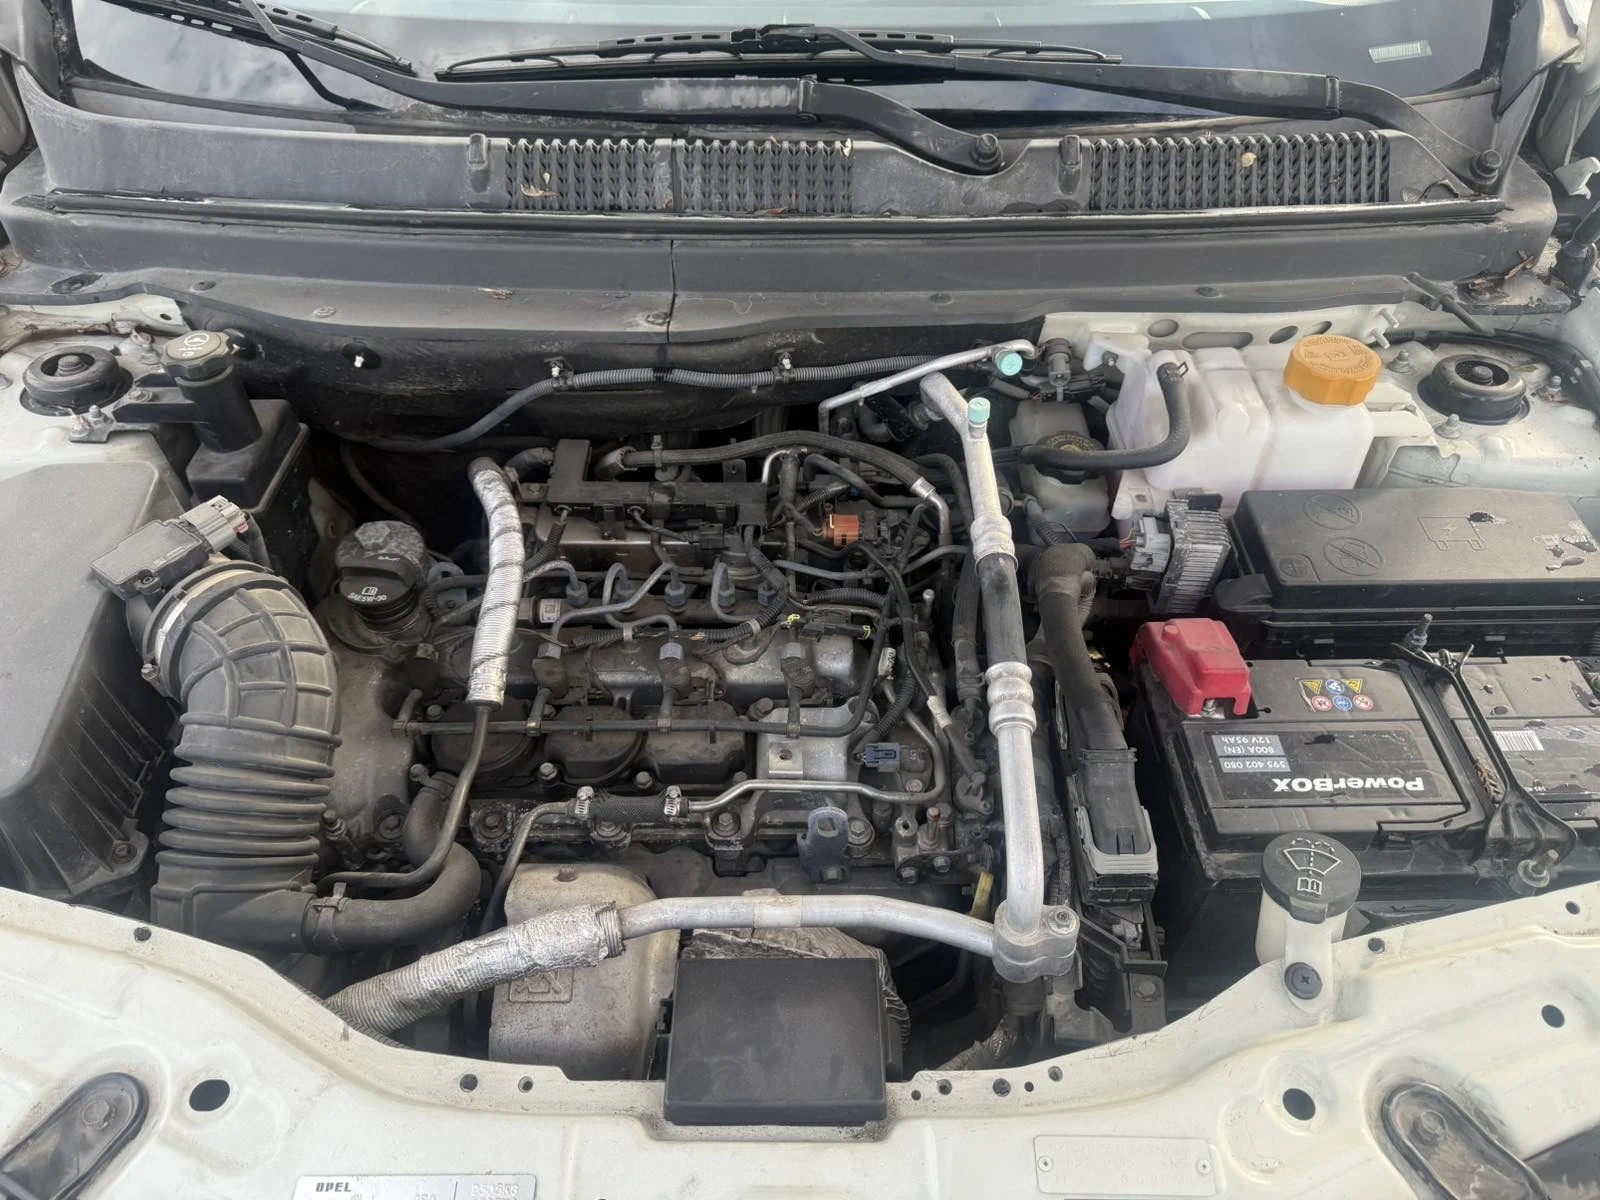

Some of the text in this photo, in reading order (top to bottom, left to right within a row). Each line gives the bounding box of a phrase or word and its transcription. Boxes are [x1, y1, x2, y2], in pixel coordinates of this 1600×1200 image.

[1221, 736, 1271, 744] 12V 95Ah
[1223, 745, 1274, 754] 800A (EN)
[1223, 760, 1286, 769] 595 402 080
[1271, 776, 1425, 792] PowerBOX
[315, 1182, 353, 1193] OPEL
